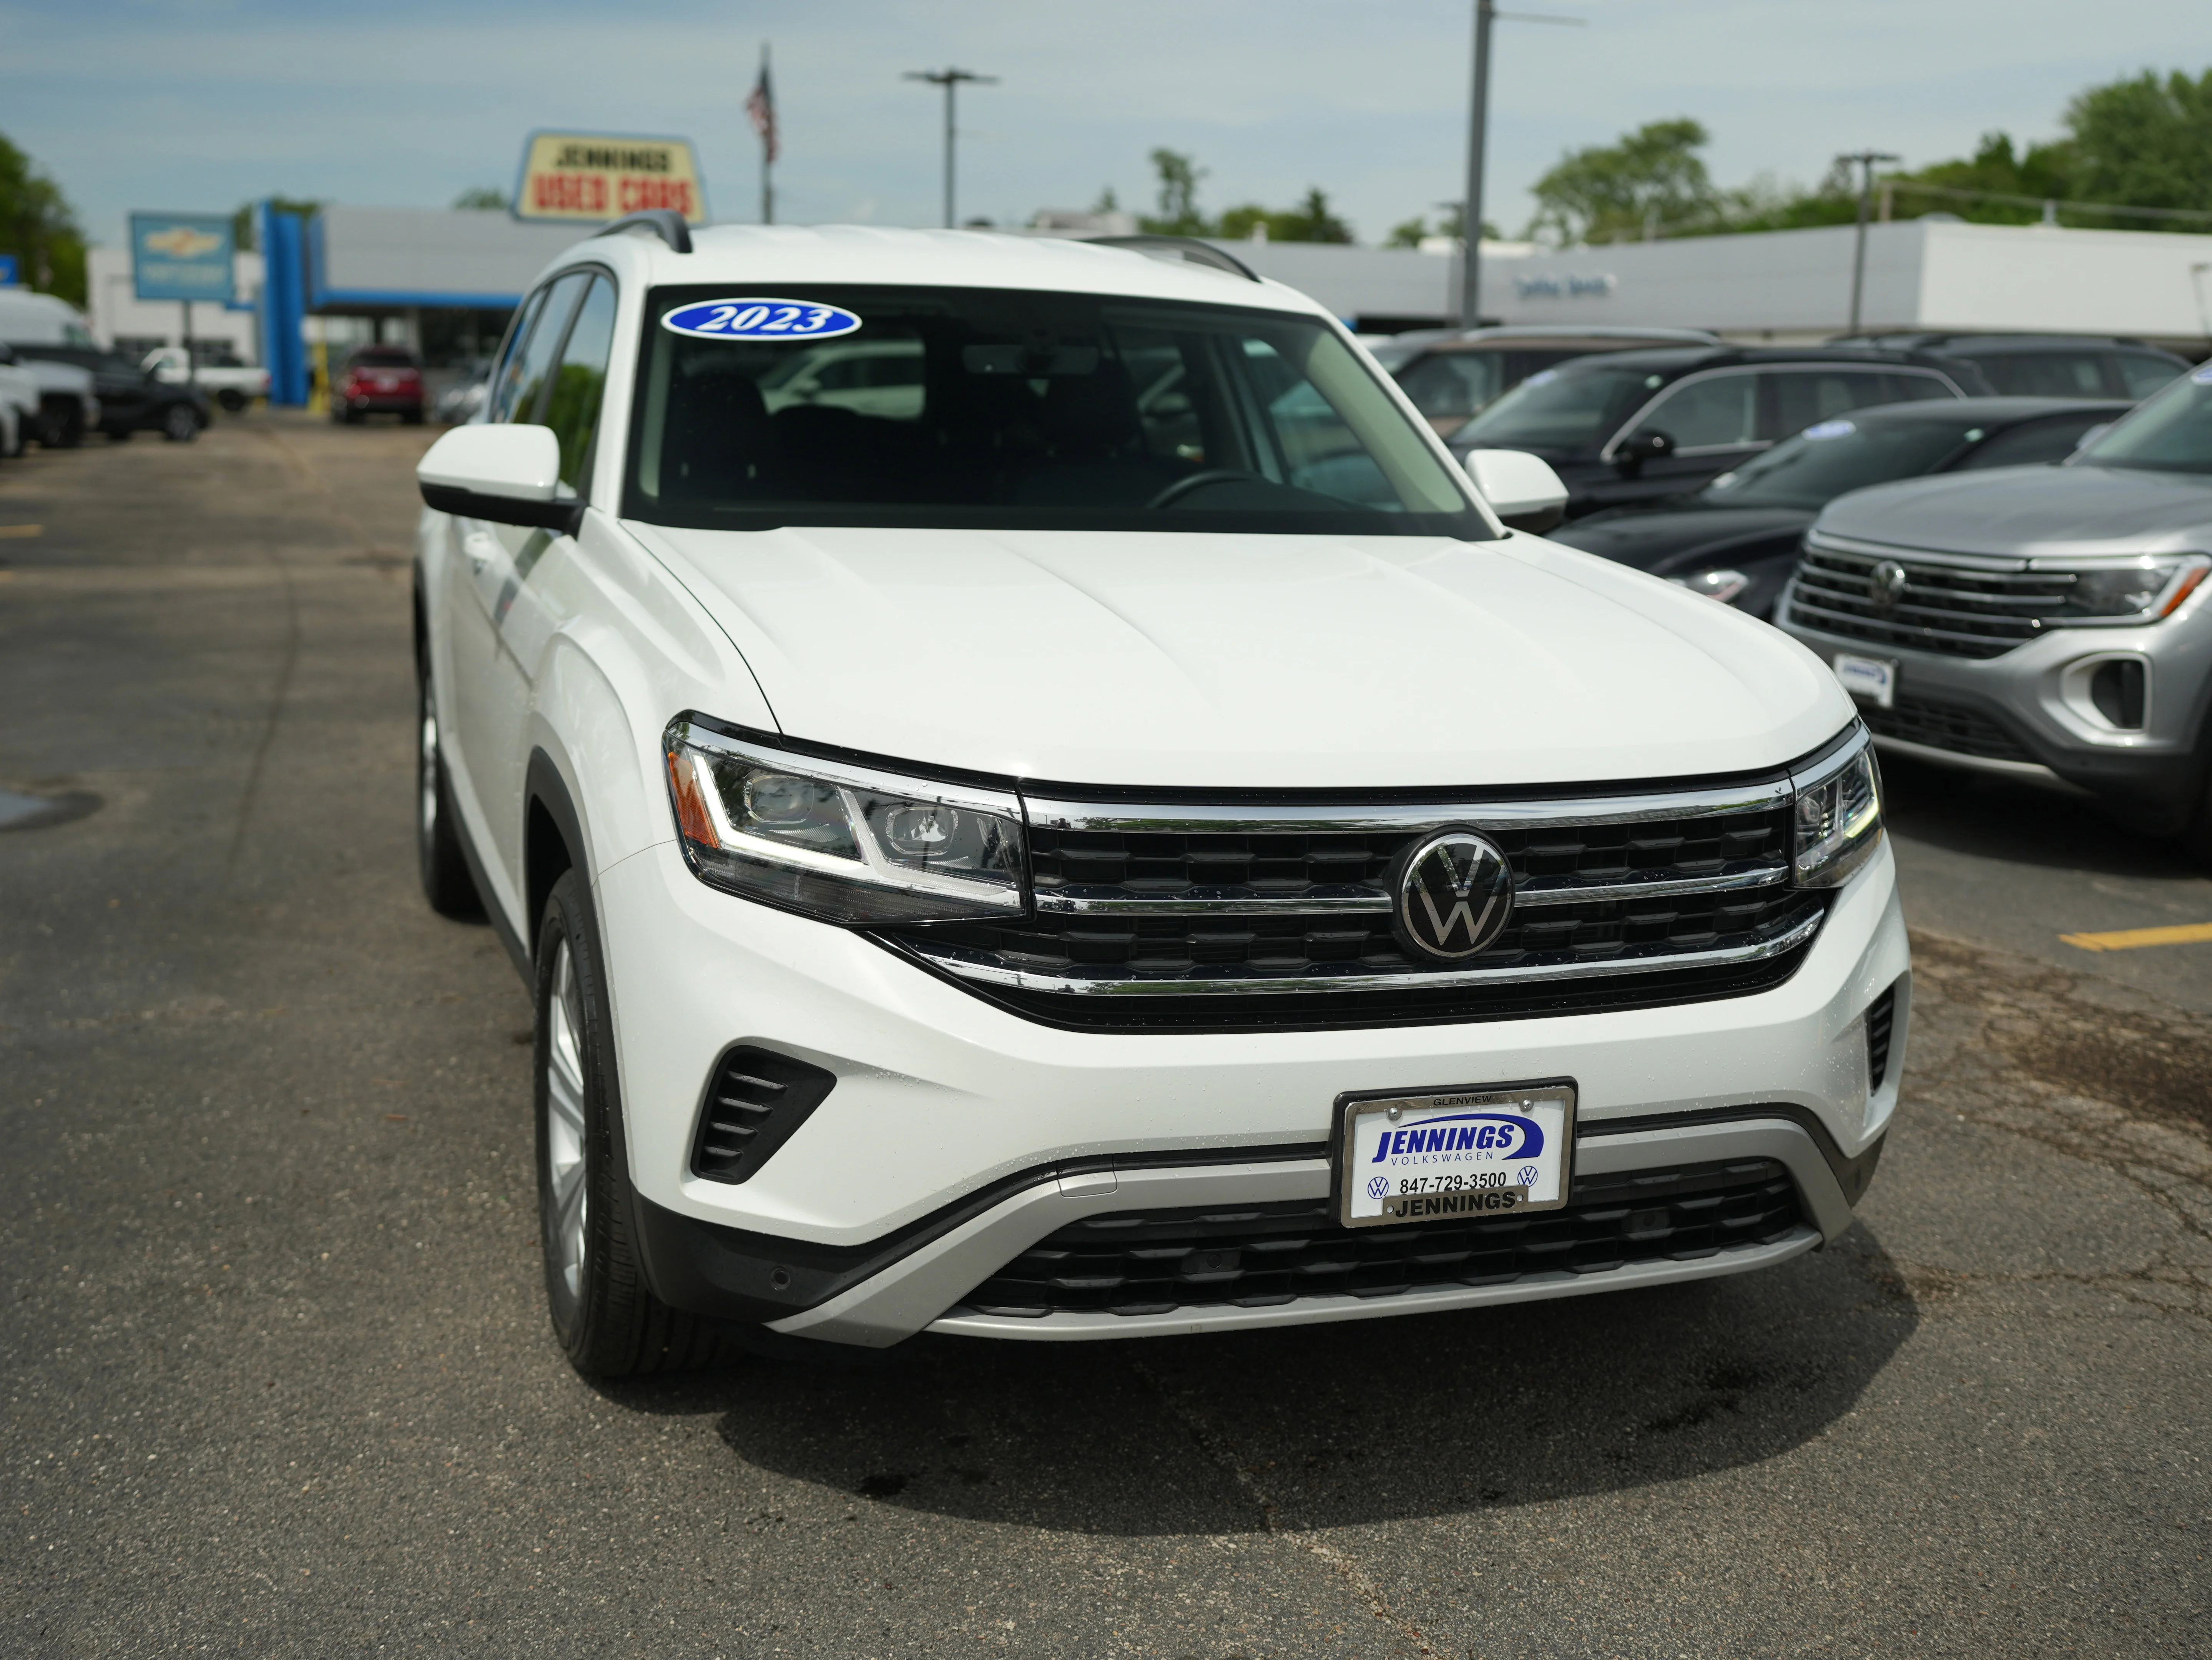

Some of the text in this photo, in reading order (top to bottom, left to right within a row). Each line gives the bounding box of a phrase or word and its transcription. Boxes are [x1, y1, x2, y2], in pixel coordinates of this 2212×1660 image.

[556, 144, 672, 173] JENNINGS
[533, 173, 692, 214] USED CARS
[695, 306, 834, 332] 2023
[1433, 1095, 1492, 1106] GLENVIEW
[1372, 1124, 1514, 1163] JENNINGS
[1391, 1151, 1493, 1166] VOLKSWAGEN
[1400, 1172, 1507, 1194] 847-729-3500
[1396, 1191, 1516, 1218] JENNINGS
